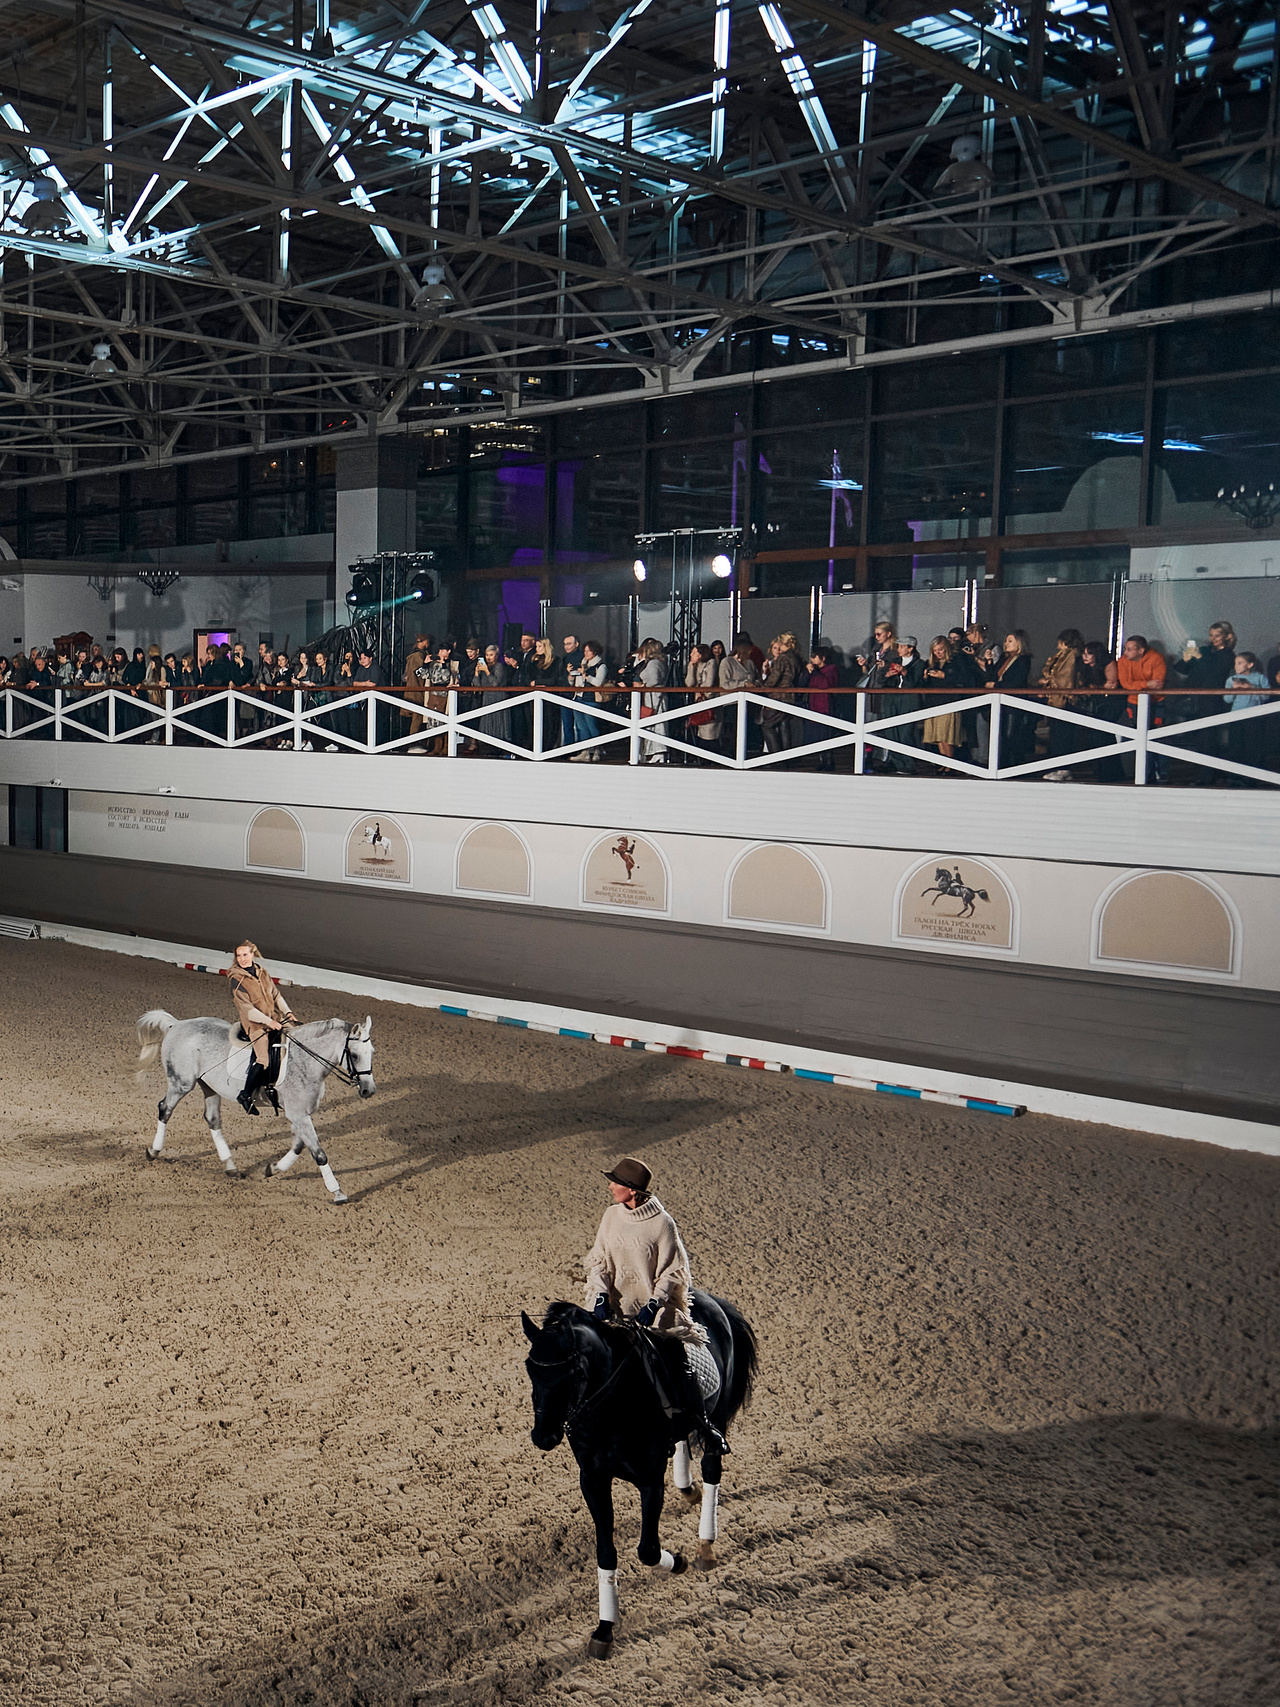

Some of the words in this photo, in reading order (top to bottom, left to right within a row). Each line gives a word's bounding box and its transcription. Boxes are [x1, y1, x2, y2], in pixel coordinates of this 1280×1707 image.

[107, 806, 137, 814] ИСКУССТВО
[142, 808, 170, 817] ВЕРХОВОЙ
[174, 811, 190, 819] ЕЗДЫ
[107, 814, 130, 822] СОСТОИТ
[139, 816, 167, 825] ИСКУССТВЕ
[118, 822, 140, 830] МЕШАТЬ
[921, 924, 953, 932] РУССКАЯ
[958, 928, 986, 936] ШКОЛА
[971, 922, 997, 931] НОГАХ
